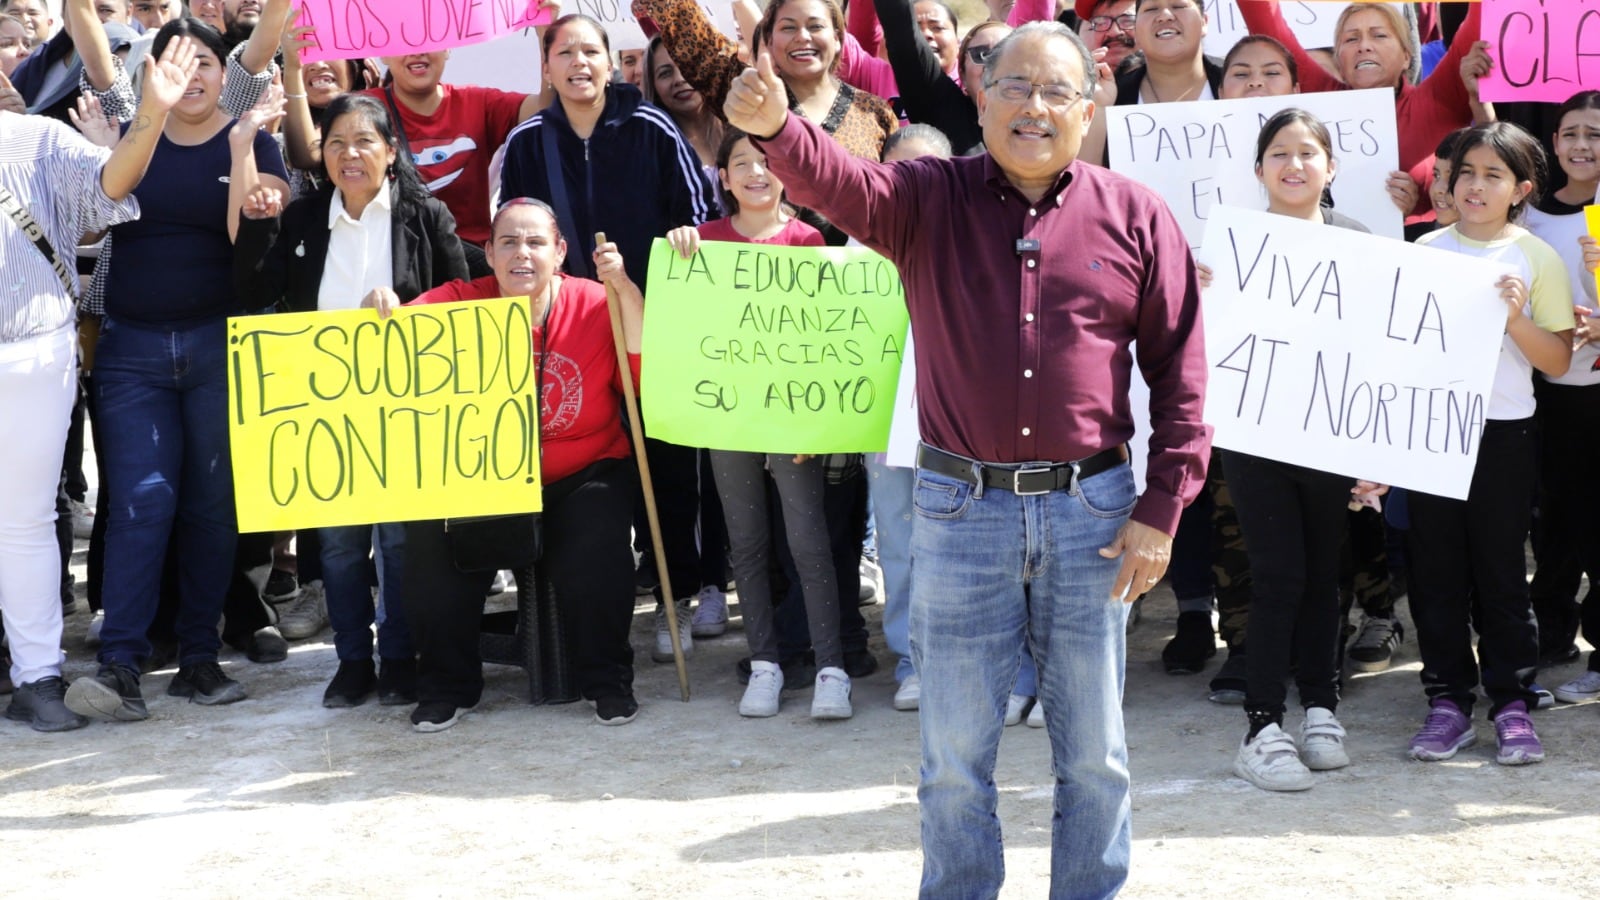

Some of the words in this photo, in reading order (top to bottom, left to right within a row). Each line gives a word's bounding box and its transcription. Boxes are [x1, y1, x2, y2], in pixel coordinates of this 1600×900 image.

[301, 3, 323, 56] A
[328, 0, 390, 51] LOS
[1124, 111, 1233, 163] PAPÁ
[666, 248, 716, 285] LA
[1227, 226, 1342, 321] VIVA
[1386, 266, 1446, 353] LA
[738, 301, 876, 334] AVANZA
[699, 335, 864, 366] GRACIAS
[880, 334, 903, 364] A
[693, 379, 739, 413] SU
[763, 375, 876, 414] APOYO
[1215, 332, 1290, 426] 4T
[1303, 350, 1484, 456] NORTEÑA
[268, 393, 535, 507] CONTIGO!
